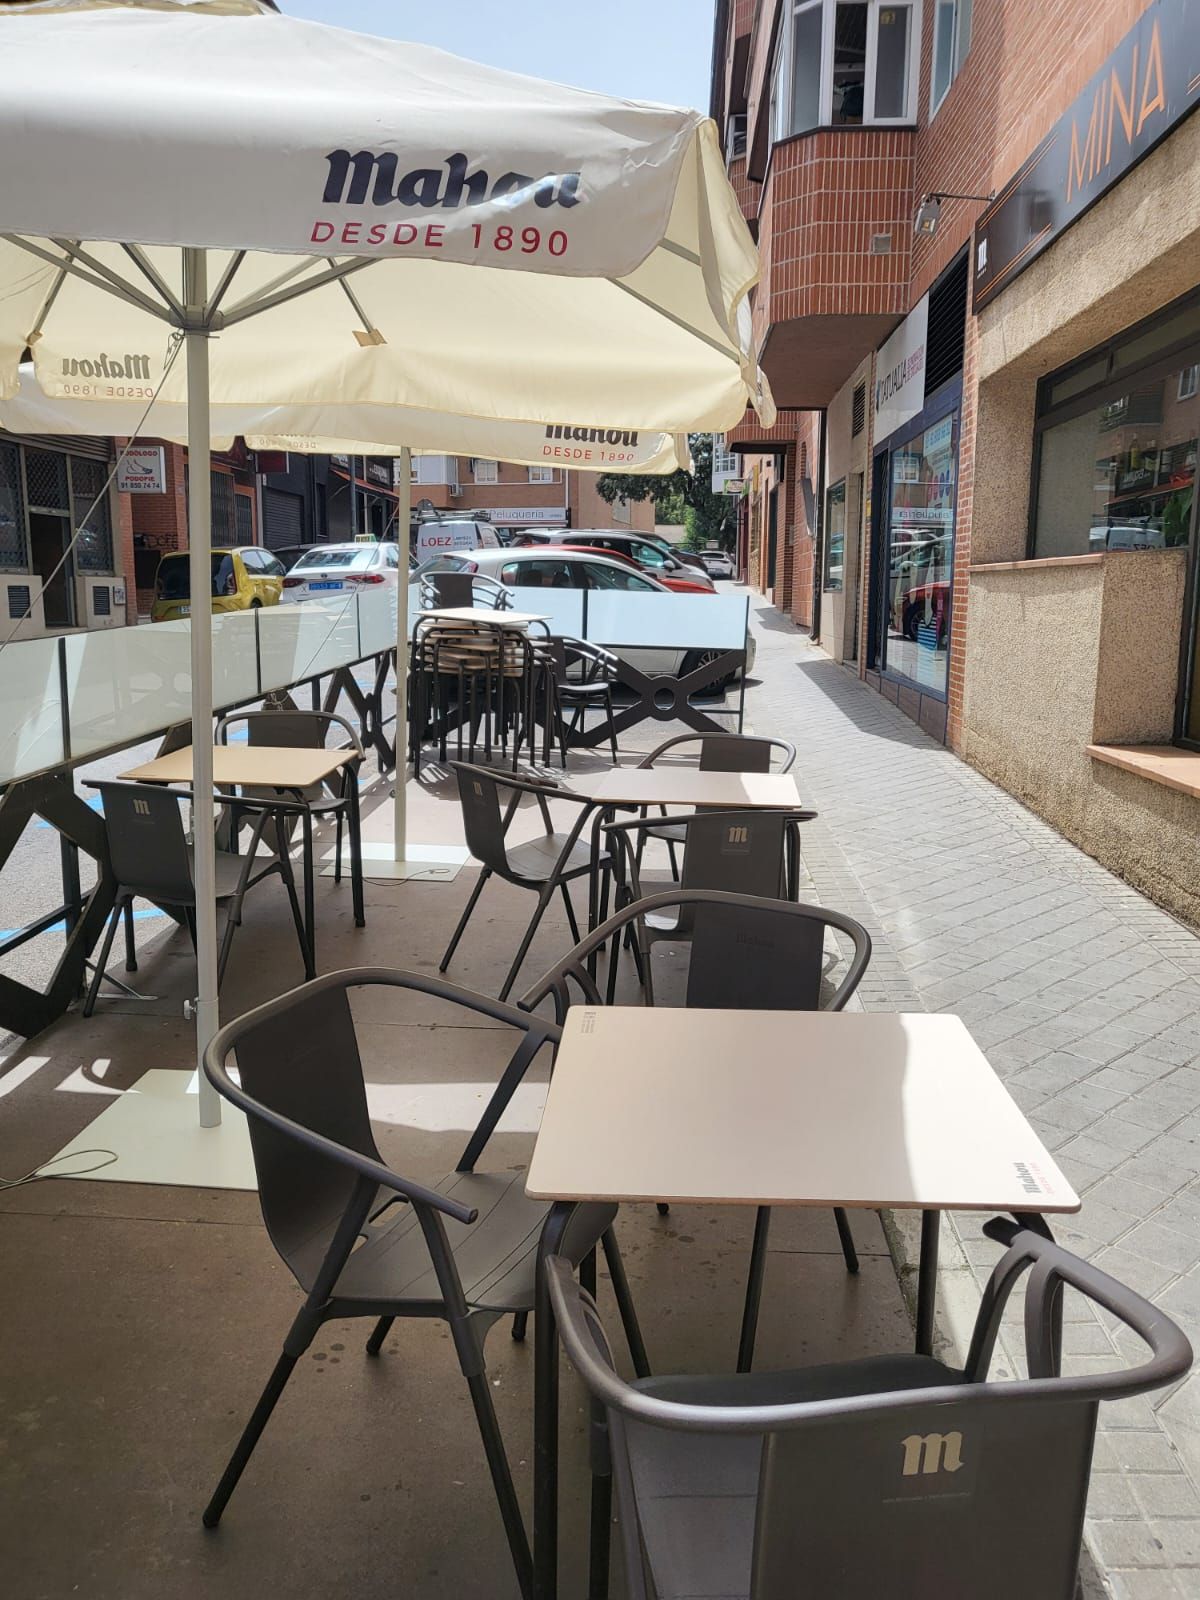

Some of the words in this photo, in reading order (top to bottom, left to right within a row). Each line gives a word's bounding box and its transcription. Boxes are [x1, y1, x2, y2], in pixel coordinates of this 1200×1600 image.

[1066, 17, 1165, 203] MINA
[310, 221, 446, 247] DESDE
[471, 223, 568, 256] 1890
[543, 445, 593, 460] DESDE
[600, 451, 635, 461] 1890
[421, 537, 452, 547] LOEZ
